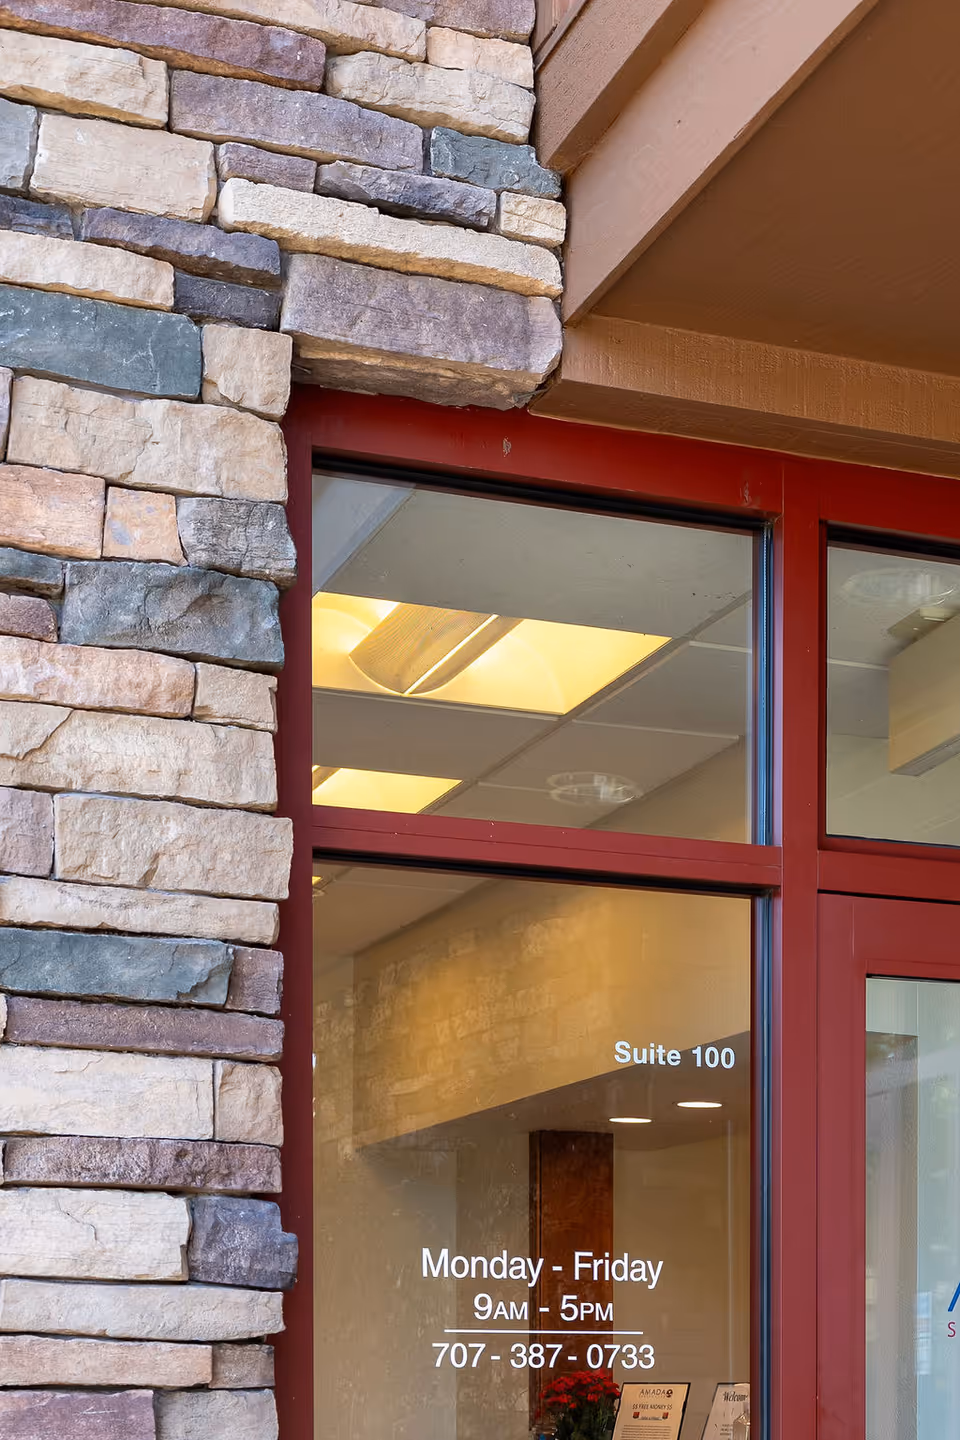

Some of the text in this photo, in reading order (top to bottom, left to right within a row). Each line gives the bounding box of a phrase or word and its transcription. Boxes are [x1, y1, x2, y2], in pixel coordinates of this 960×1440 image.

[614, 1040, 736, 1069] Suite 100
[422, 1247, 545, 1289] Monday
[573, 1251, 664, 1290] Friday
[473, 1293, 529, 1321] 9AM
[560, 1294, 614, 1321] 5PM
[640, 1388, 666, 1396] AMADA
